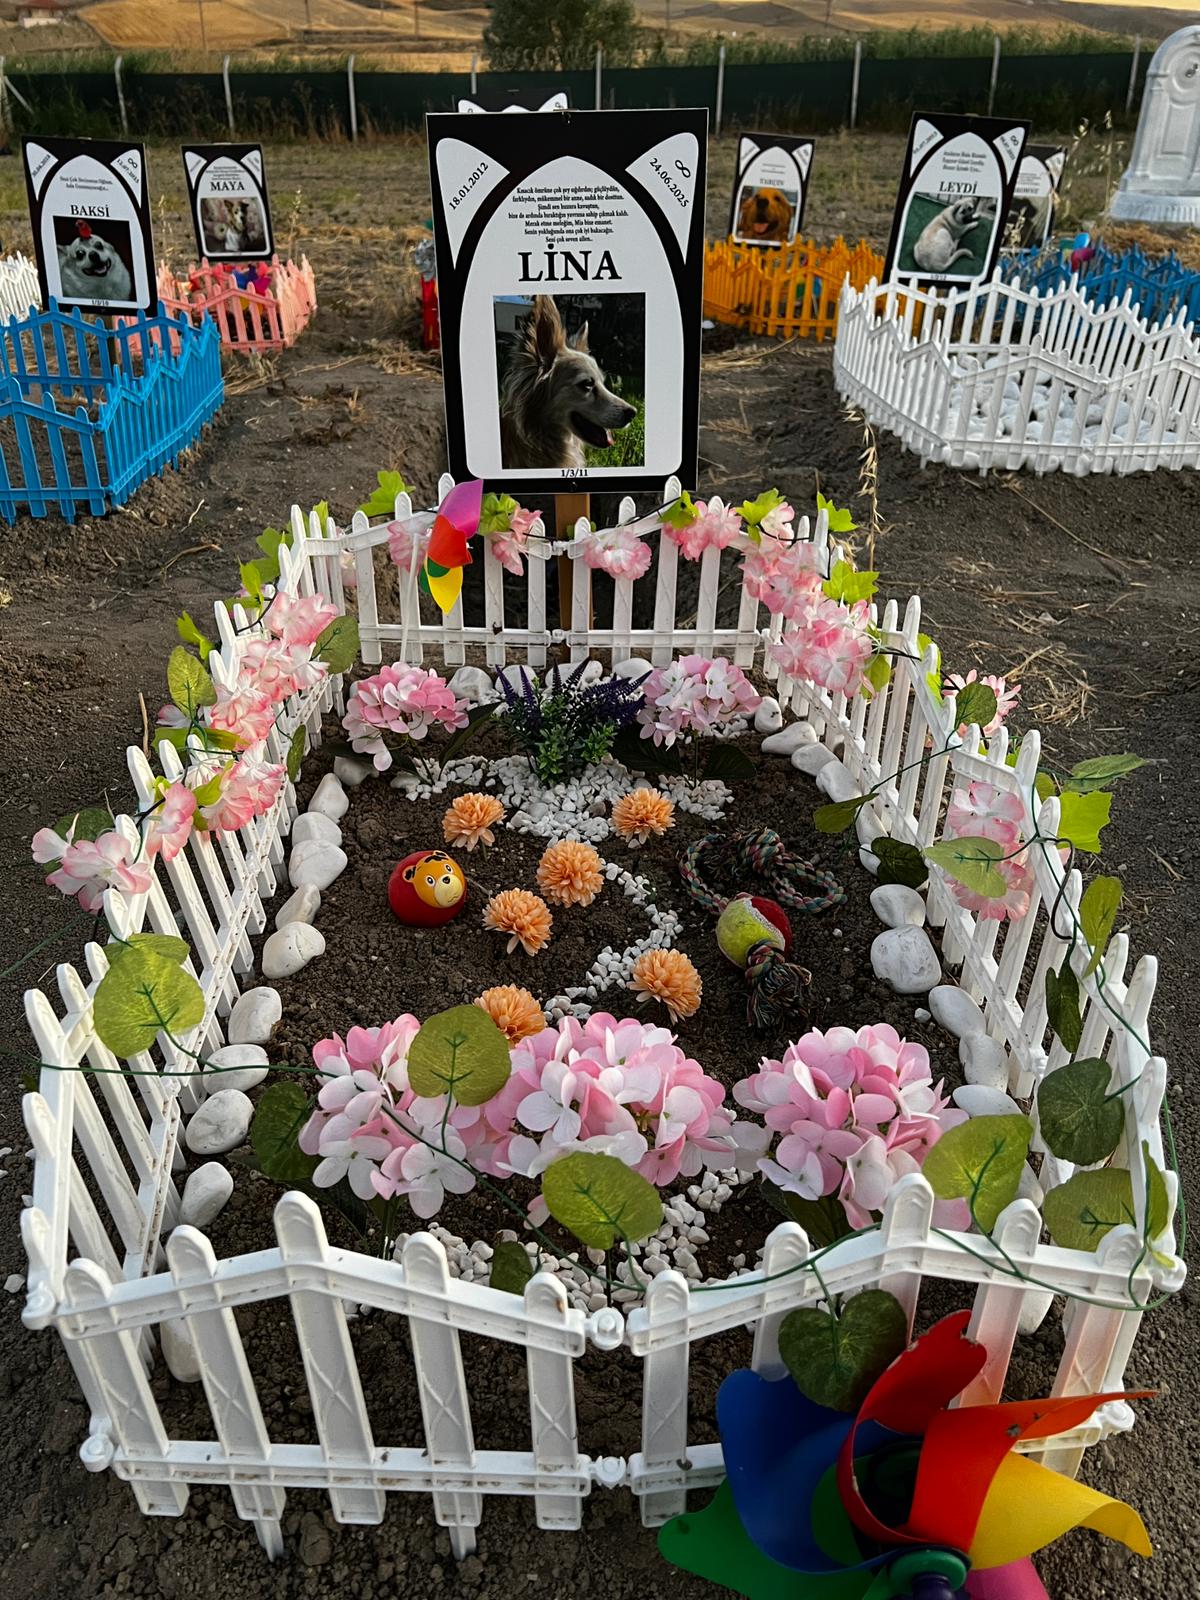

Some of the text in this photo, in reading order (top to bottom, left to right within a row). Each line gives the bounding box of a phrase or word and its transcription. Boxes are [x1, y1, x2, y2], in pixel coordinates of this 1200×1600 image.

[210, 181, 245, 191] MAYA
[448, 162, 489, 210] 18.01.2012
[650, 158, 689, 207] 24.06.2025
[939, 181, 978, 194] LEYDİ
[70, 204, 110, 217] BAKSİ
[517, 243, 623, 281] LİNA
[561, 469, 588, 479] 1/3/11
